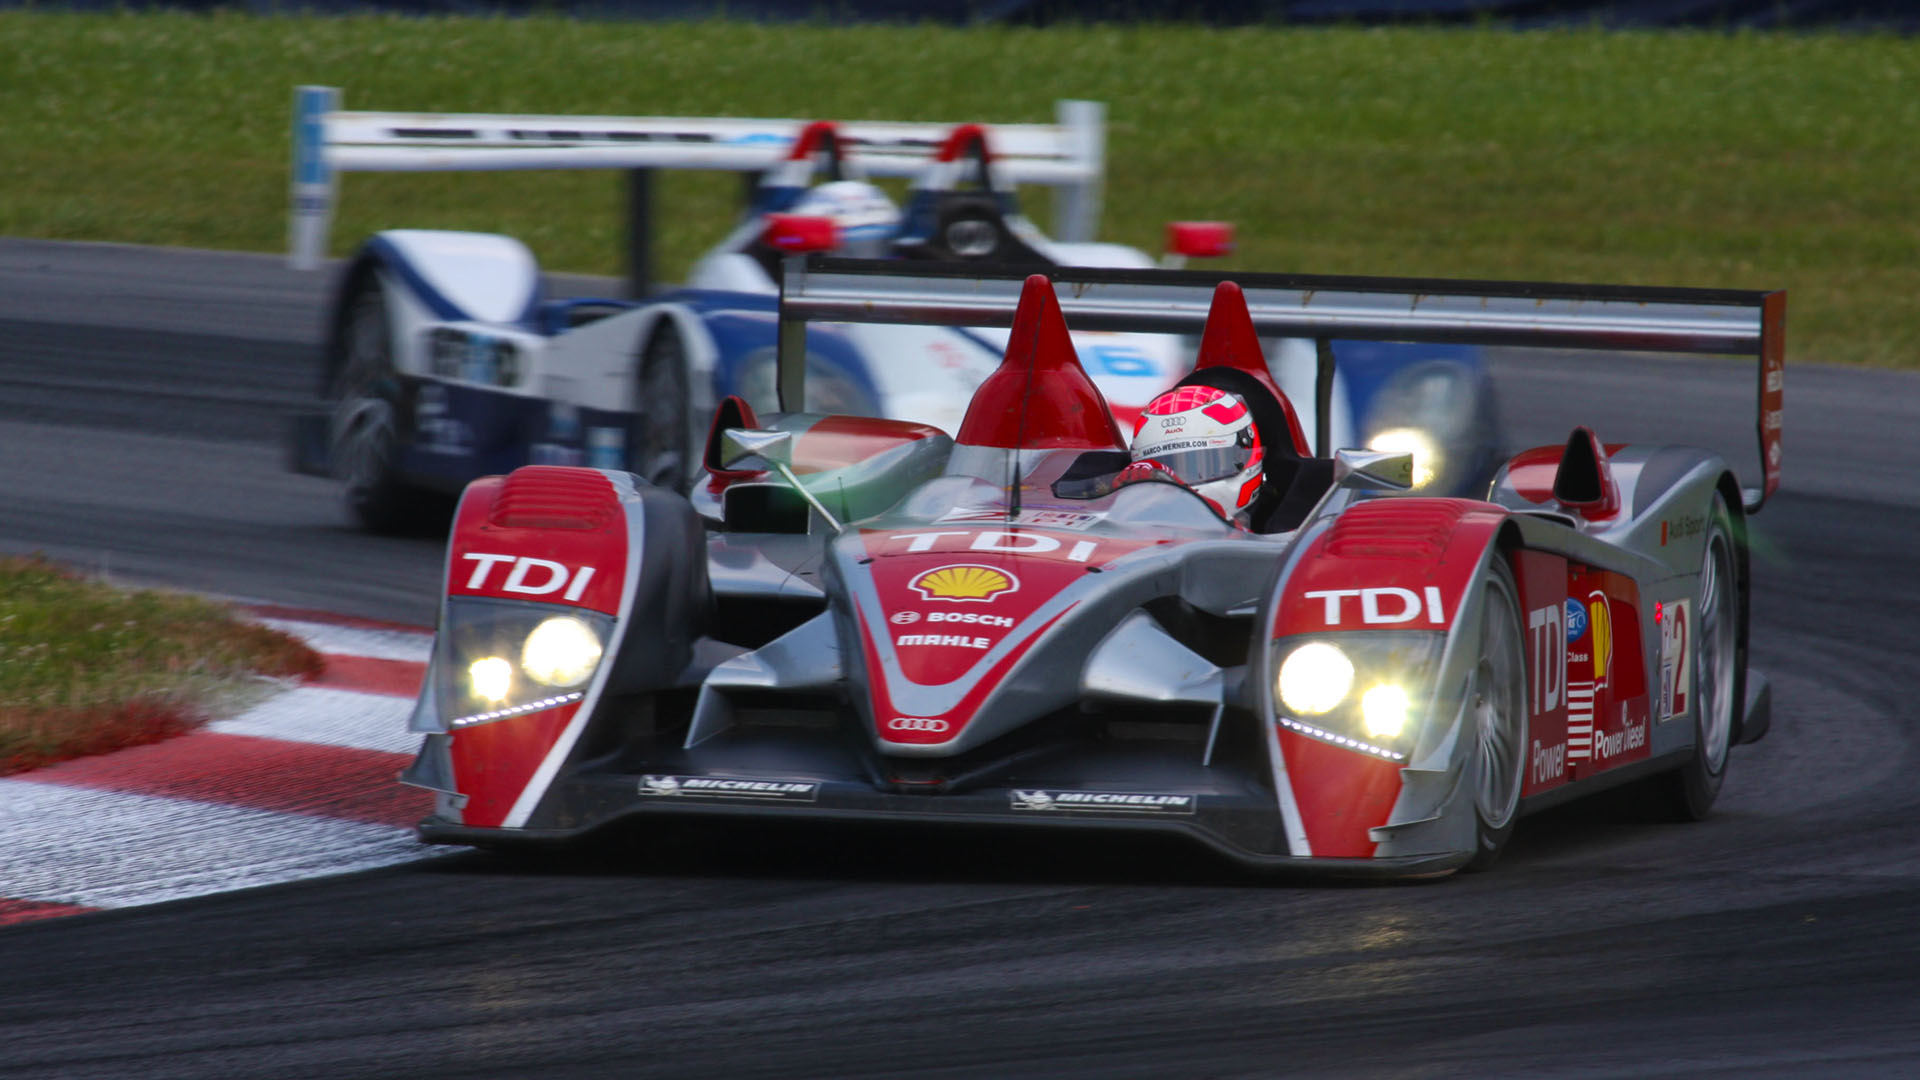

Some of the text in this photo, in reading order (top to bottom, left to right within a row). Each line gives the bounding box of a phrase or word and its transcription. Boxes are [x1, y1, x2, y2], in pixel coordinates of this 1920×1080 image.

[1143, 440, 1208, 456] MARCO-WERNER.COM
[890, 531, 1097, 563] TDI
[462, 553, 597, 602] TDI
[926, 612, 1014, 628] BOSCH
[1304, 586, 1446, 625] TDI
[896, 634, 990, 649] MAHLE
[1529, 601, 1567, 715] TDI
[1672, 603, 1687, 716] 2
[1533, 740, 1566, 785] Power
[682, 779, 814, 792] MICHELIN
[1056, 793, 1191, 805] MICHELIN
